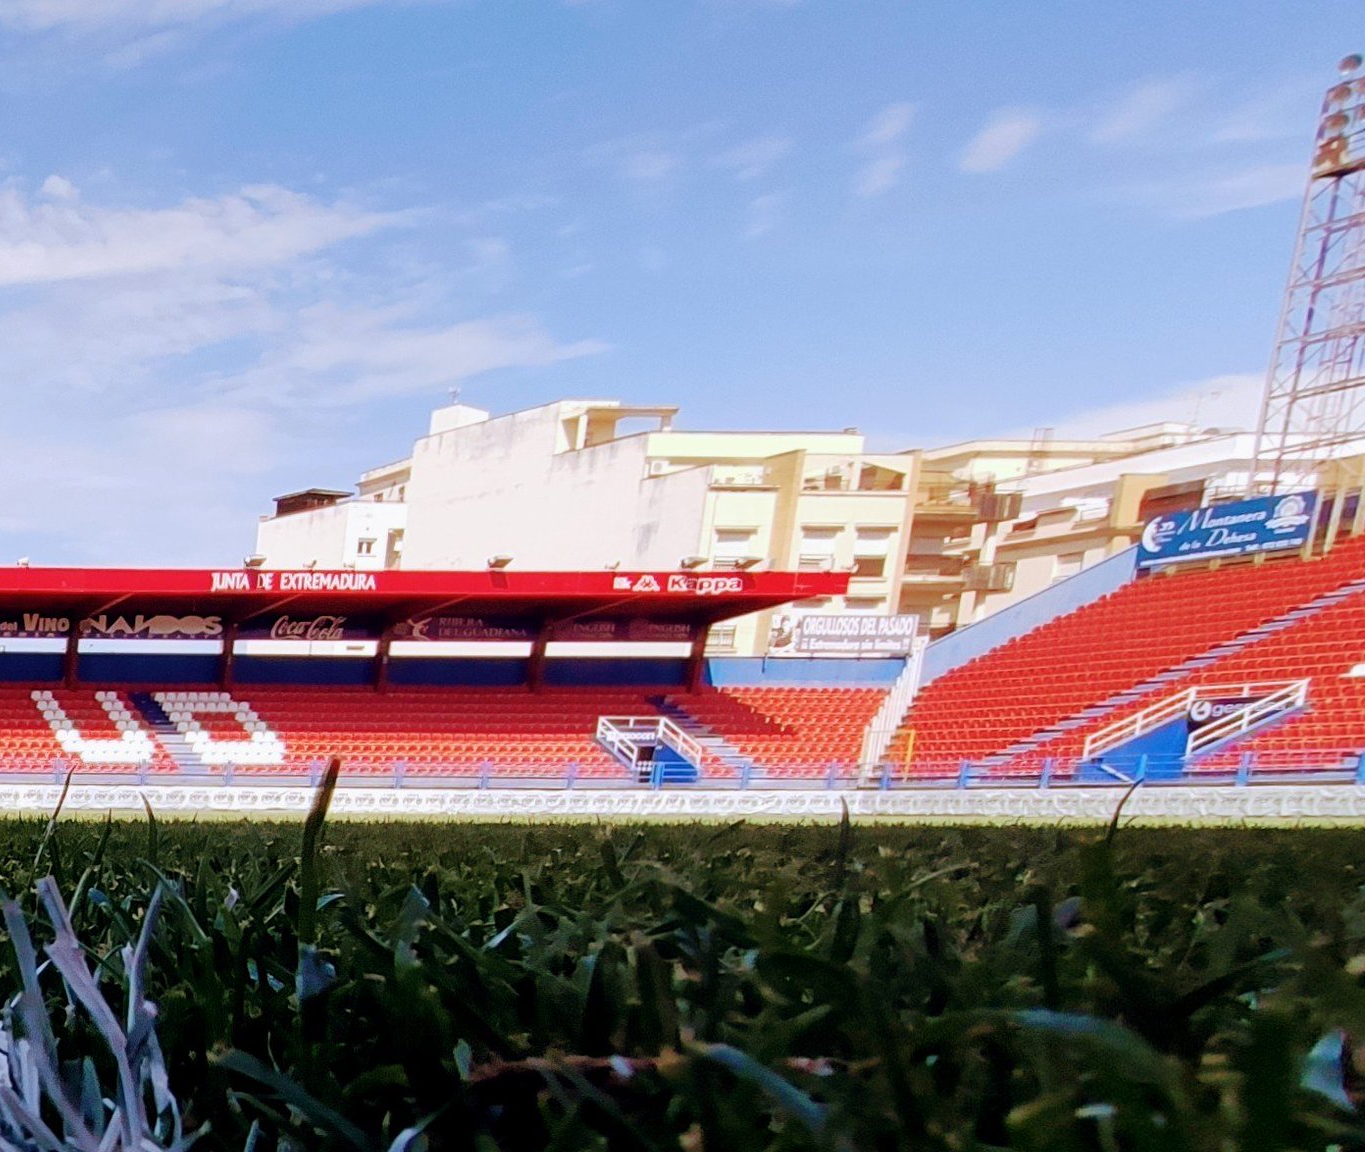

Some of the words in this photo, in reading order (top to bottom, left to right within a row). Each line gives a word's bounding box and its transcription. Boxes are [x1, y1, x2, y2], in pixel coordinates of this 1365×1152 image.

[1177, 507, 1267, 535] Montanera
[211, 573, 250, 592] JUNTA
[256, 573, 273, 590] DE
[280, 573, 376, 591] EXTREMADURA
[667, 574, 743, 595] Kappa
[803, 616, 860, 635] ORGULLOSOS
[860, 617, 877, 635] DEL
[878, 616, 913, 636] PASADO
[30, 690, 286, 764] UD
